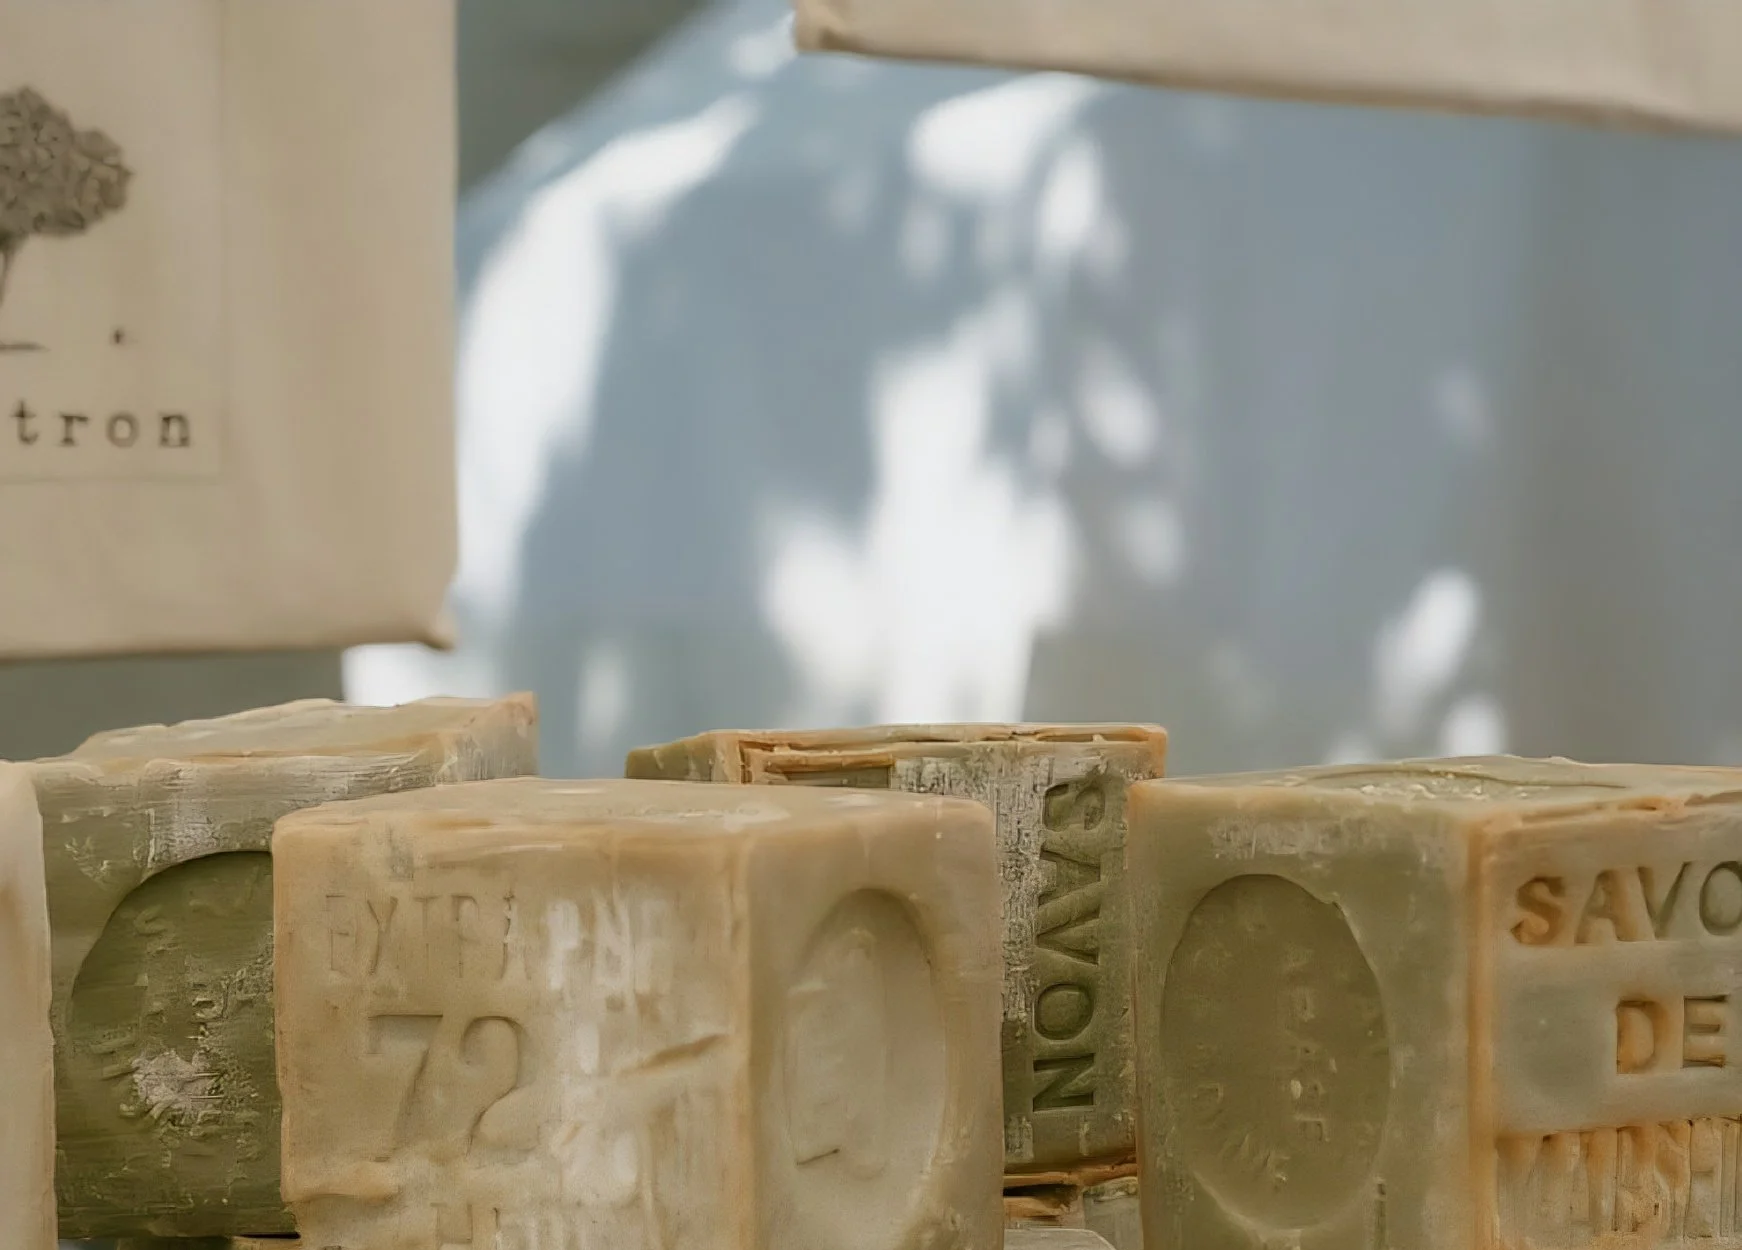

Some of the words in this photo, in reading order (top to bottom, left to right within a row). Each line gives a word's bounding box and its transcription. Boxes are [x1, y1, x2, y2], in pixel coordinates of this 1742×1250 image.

[12, 398, 192, 448] tron
[1032, 782, 1106, 1113] SAVON
[1615, 994, 1728, 1075] DE
